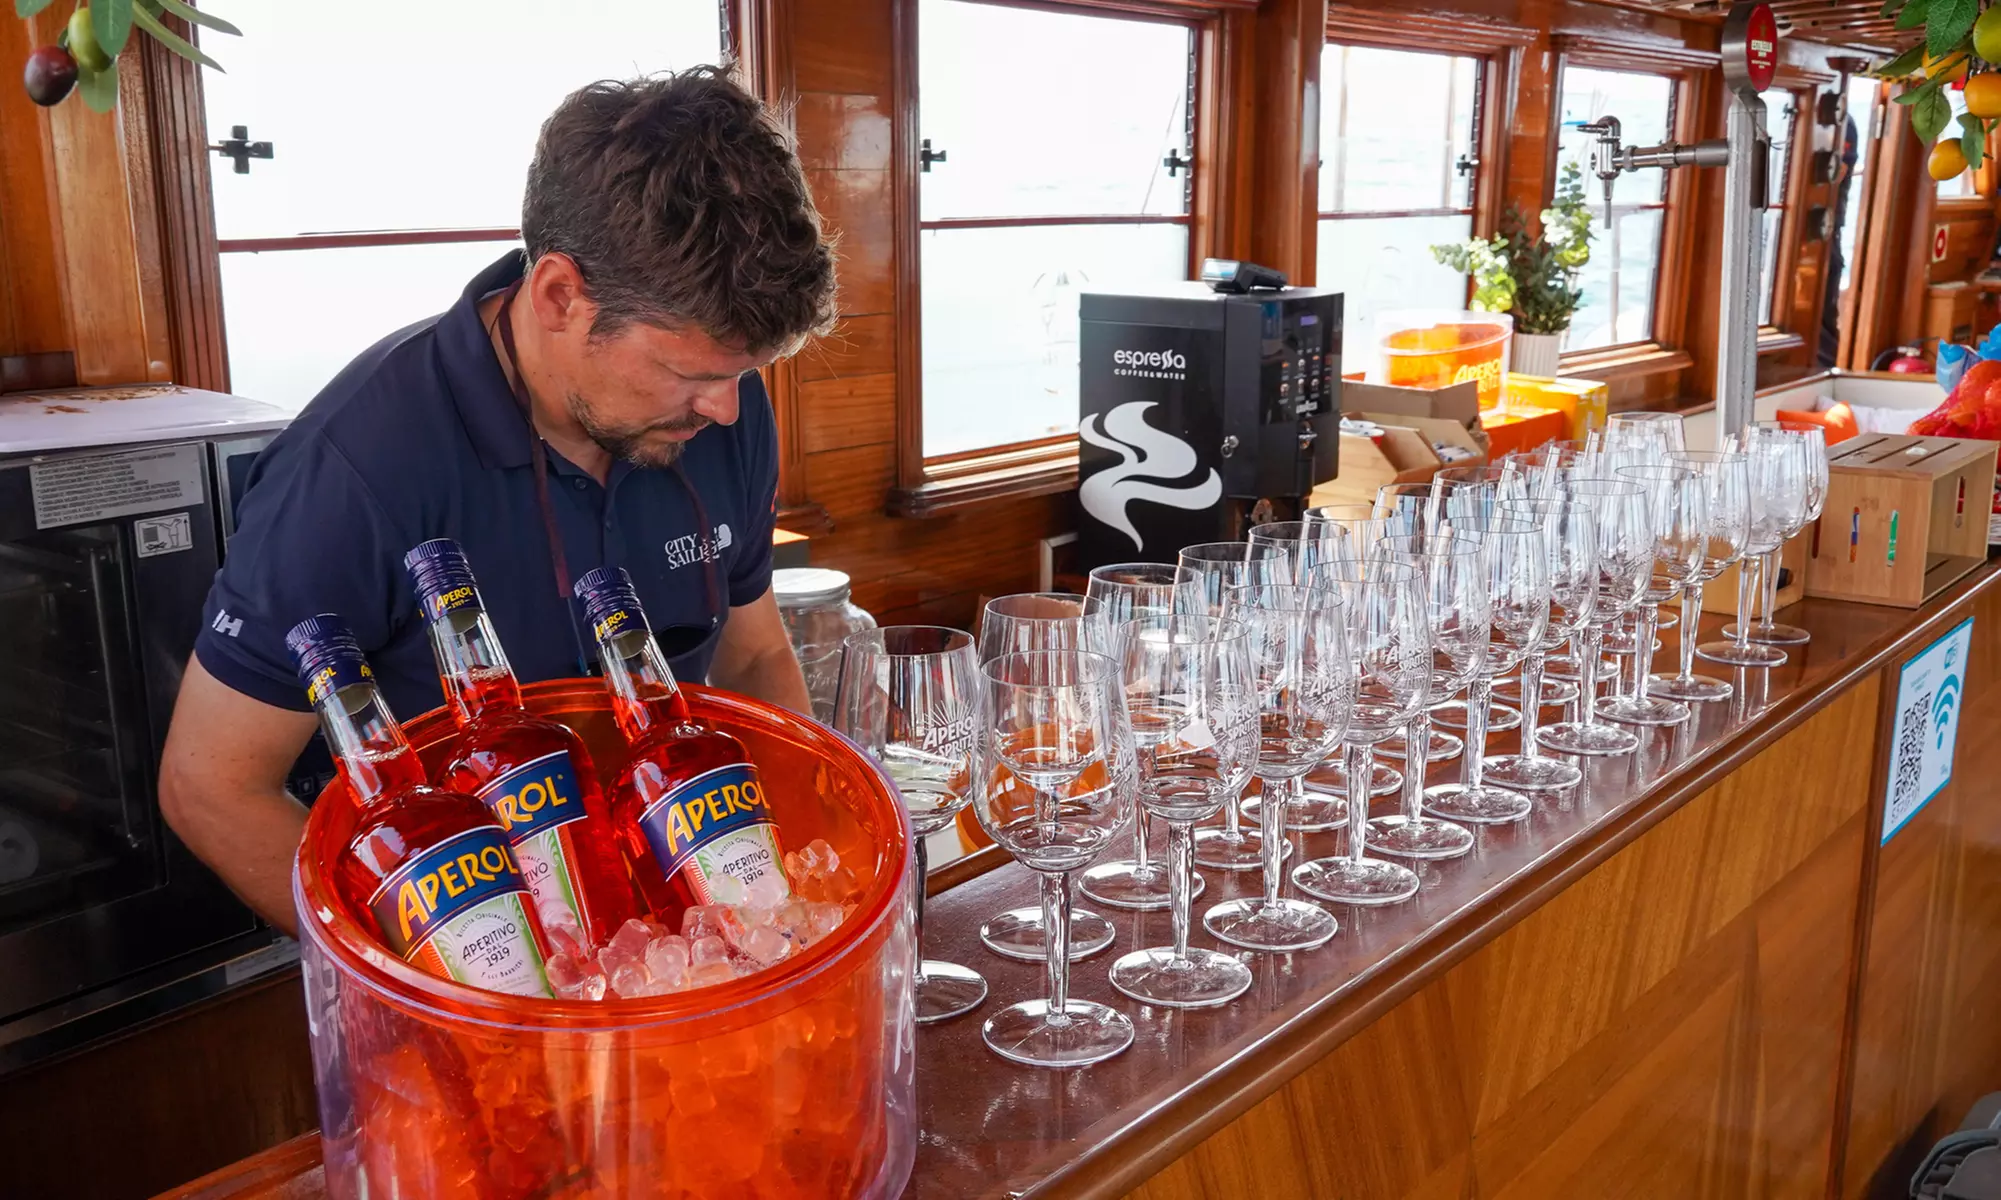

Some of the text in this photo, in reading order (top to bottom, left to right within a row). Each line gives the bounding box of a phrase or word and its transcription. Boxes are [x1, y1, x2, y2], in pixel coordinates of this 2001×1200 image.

[1452, 358, 1501, 386] APERO
[664, 532, 698, 556] CITY
[436, 586, 474, 612] APEROL
[595, 610, 629, 643] APEROL
[494, 776, 568, 832] ROL
[666, 780, 772, 858] APEROL
[722, 848, 770, 875] APERITIVO
[398, 845, 519, 942] APEROL
[462, 922, 517, 961] APERITIVO
[486, 944, 502, 954] DAL
[485, 946, 511, 968] 1919
